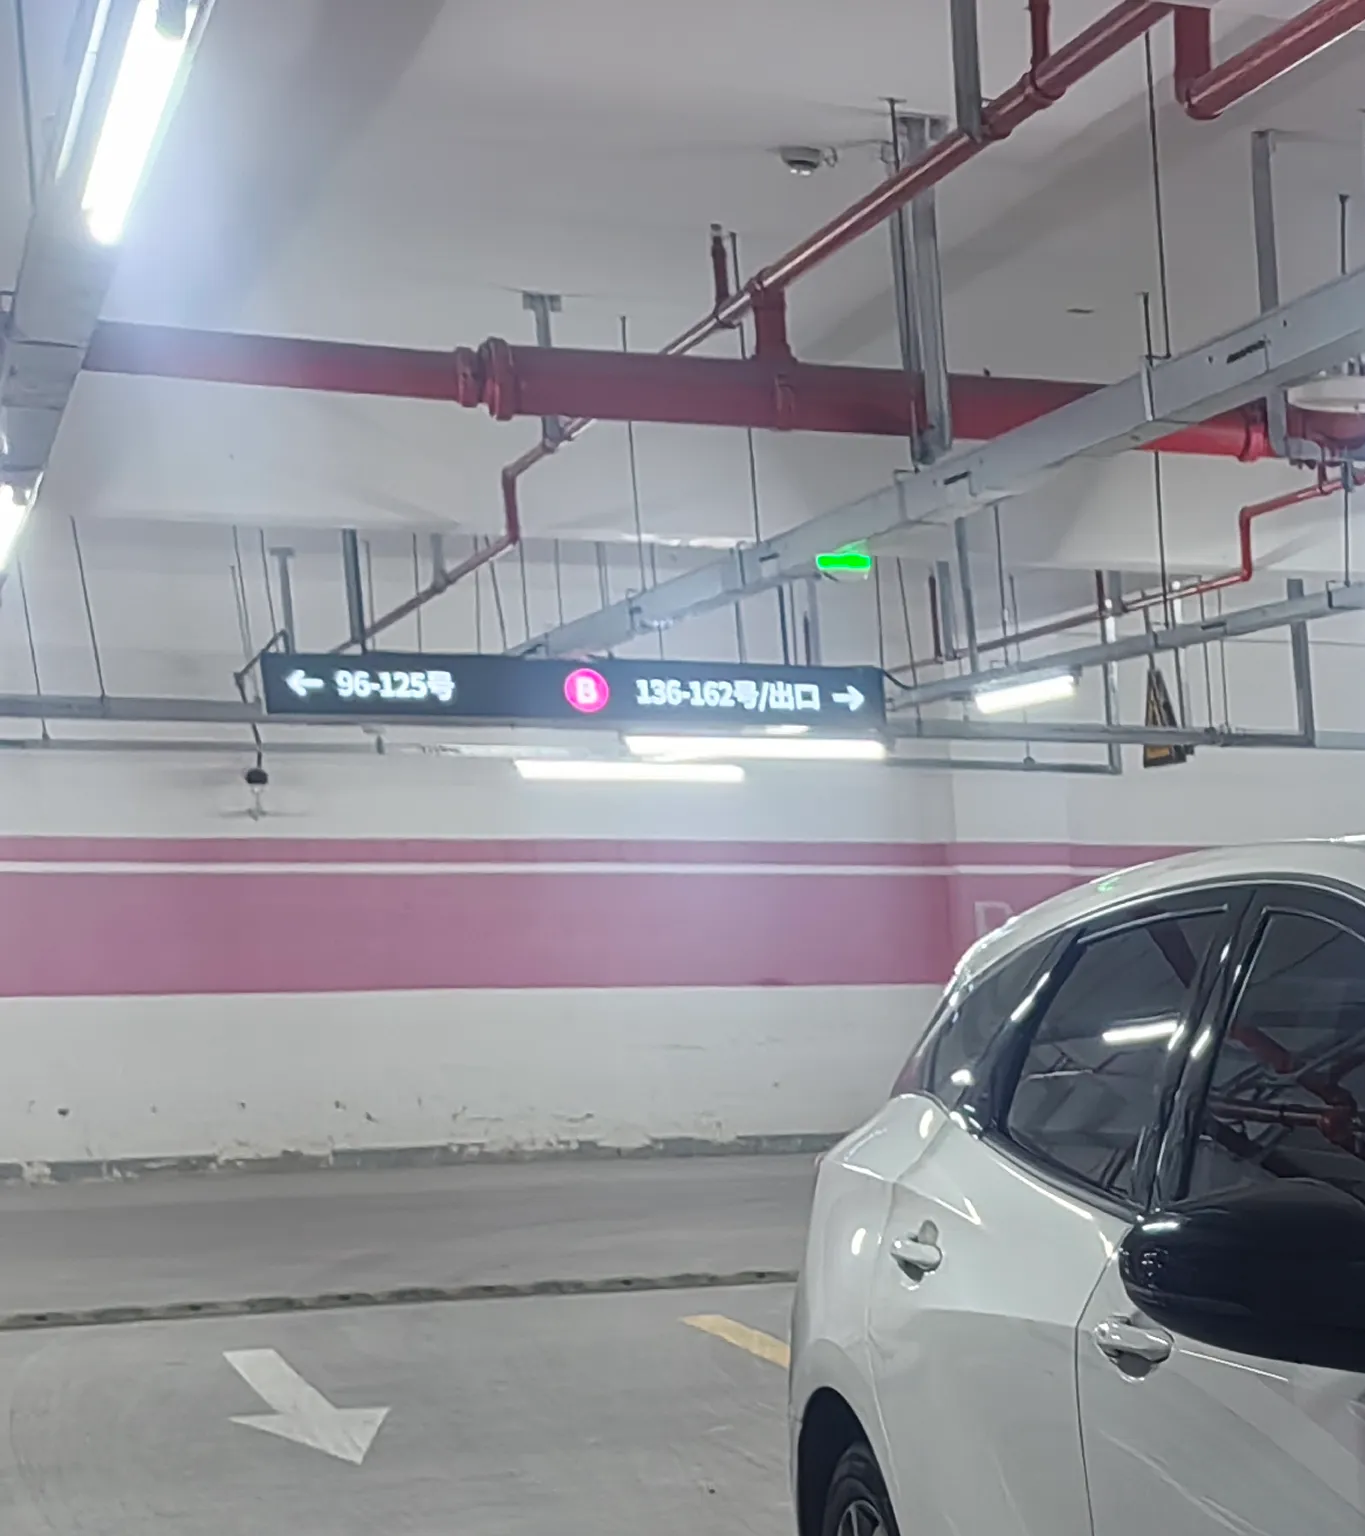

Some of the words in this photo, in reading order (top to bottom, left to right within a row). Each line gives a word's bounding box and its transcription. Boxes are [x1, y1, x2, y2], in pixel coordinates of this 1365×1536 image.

[335, 669, 456, 702] 96-125号
[575, 676, 598, 704] B
[636, 679, 821, 713] 136-162号/出口
